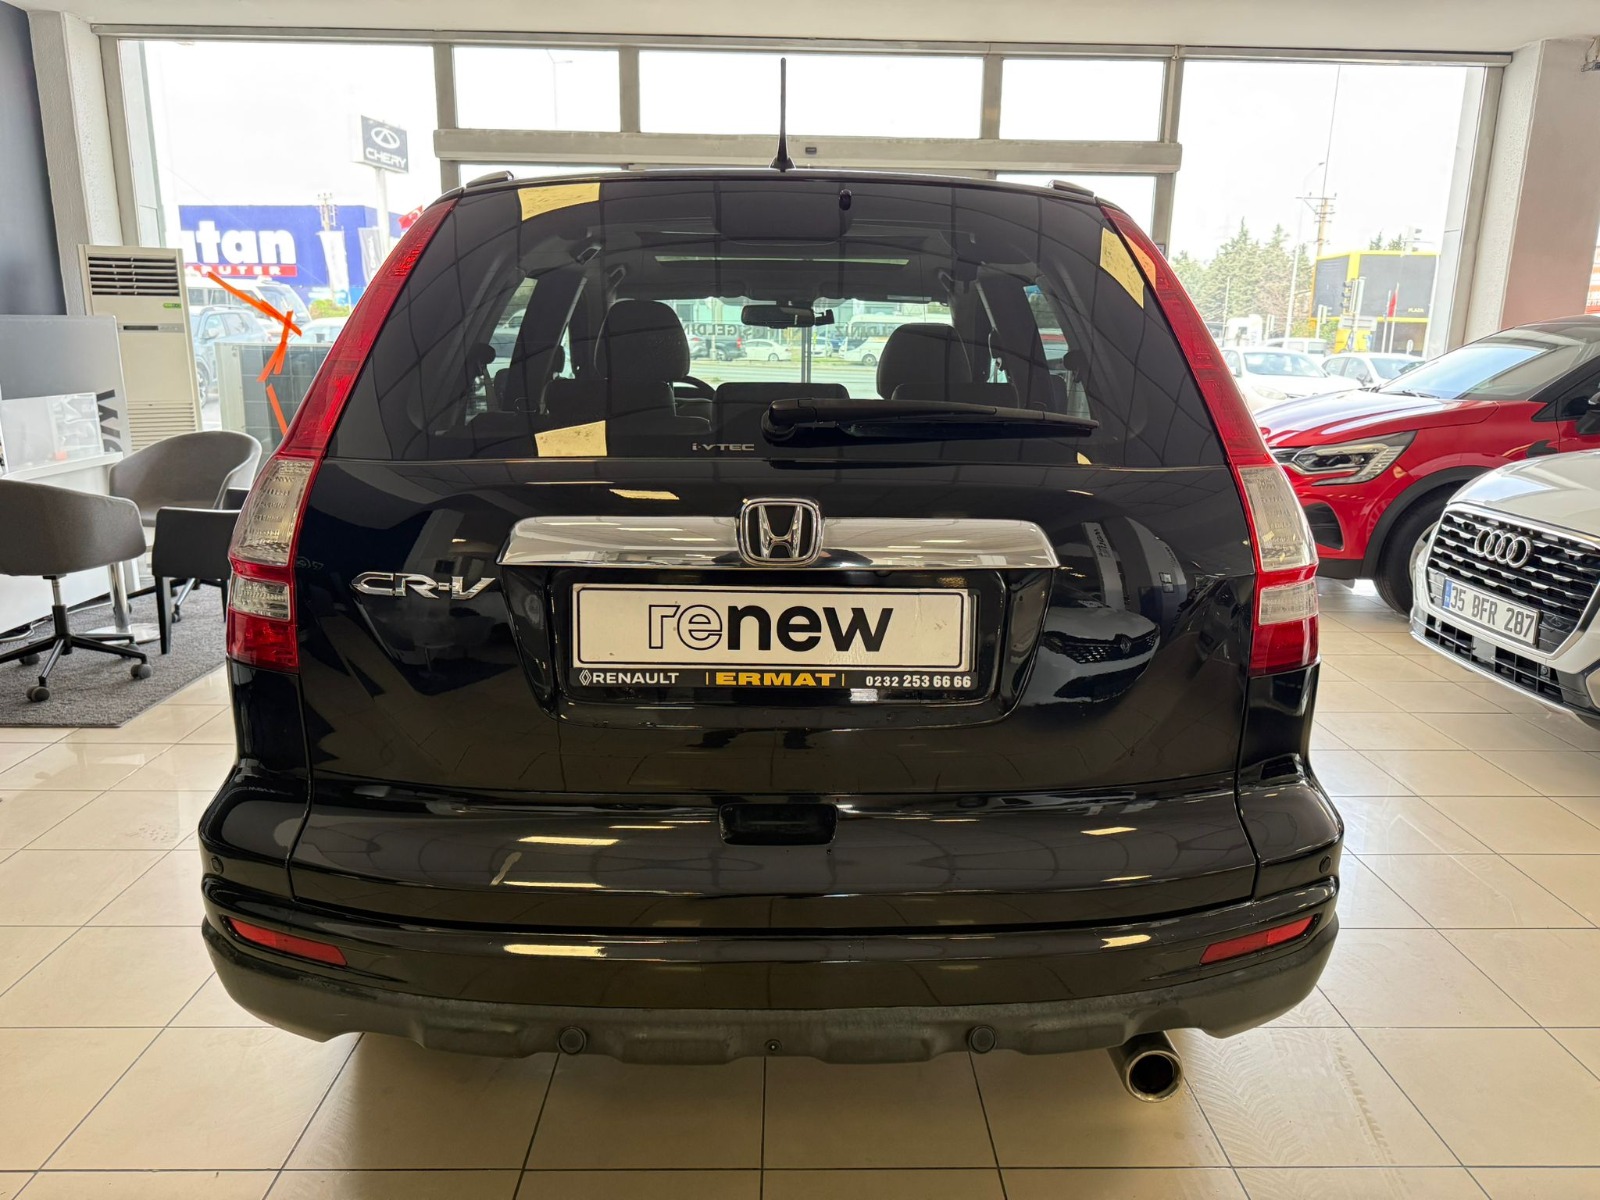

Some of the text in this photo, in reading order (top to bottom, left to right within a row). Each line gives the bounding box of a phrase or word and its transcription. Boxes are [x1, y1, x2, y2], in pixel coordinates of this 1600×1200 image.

[366, 147, 407, 168] CHERY
[351, 571, 496, 600] CR-V
[1450, 585, 1535, 638] 35 BFR 287
[648, 604, 894, 652] renew
[592, 672, 972, 688] RENAULT ERMAT 0232 253 66 66
